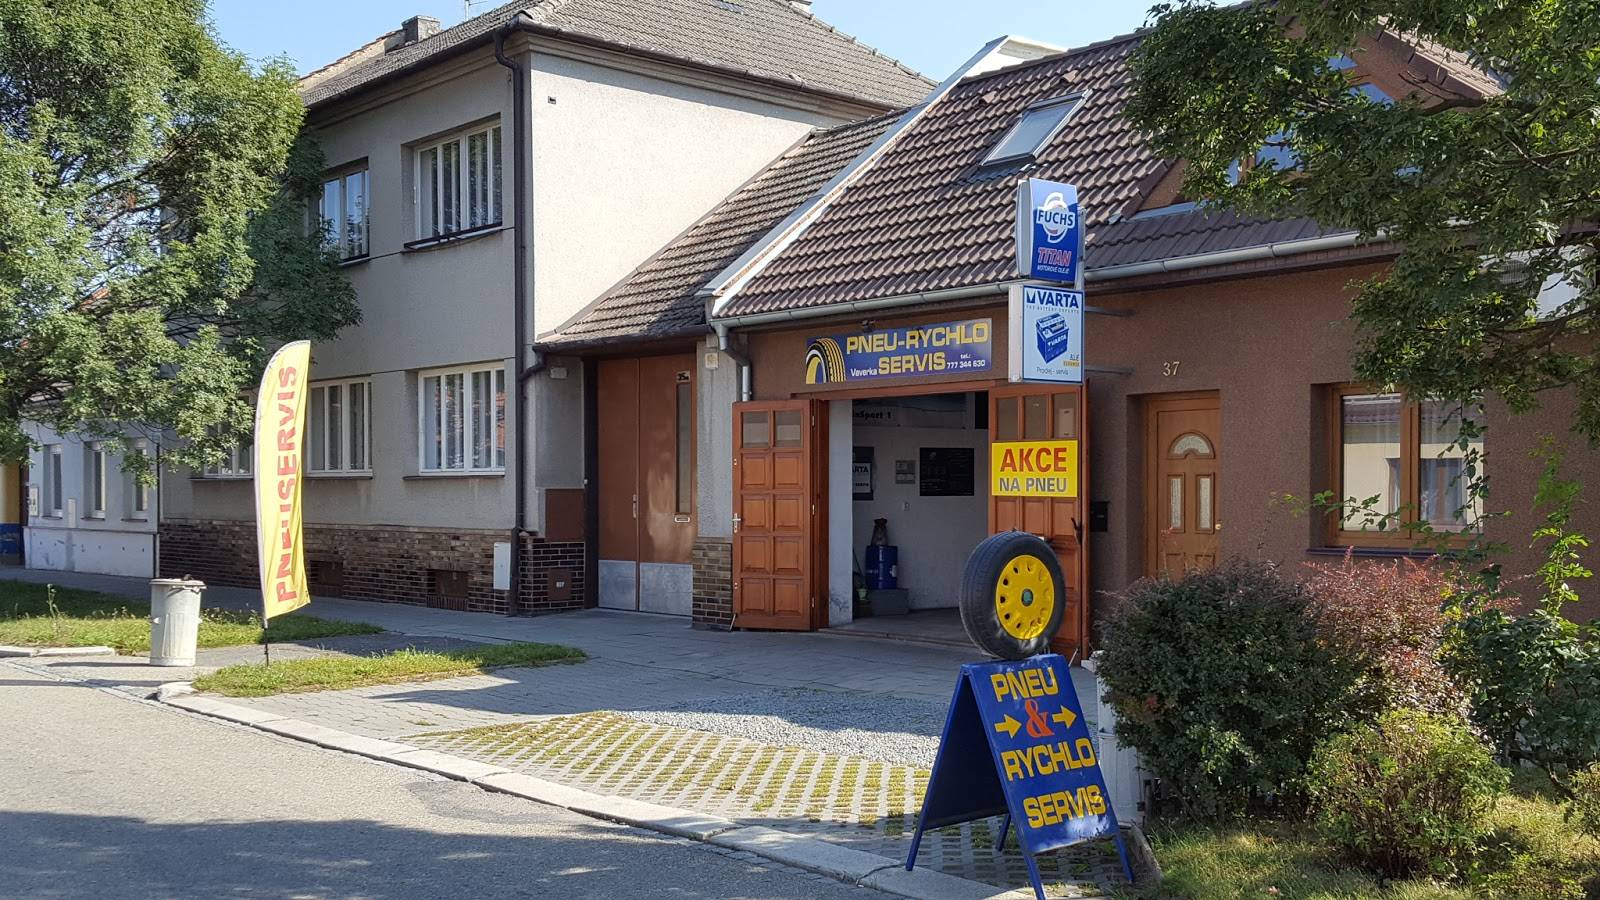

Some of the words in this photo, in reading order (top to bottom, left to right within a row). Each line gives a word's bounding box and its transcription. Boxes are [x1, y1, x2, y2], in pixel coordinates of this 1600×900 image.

[1038, 211, 1074, 226] FUCHS
[1038, 247, 1072, 266] TITAN
[1037, 290, 1079, 308] VARTA
[846, 322, 989, 354] PNEU-RYCHLO
[878, 352, 946, 375] SERVIS
[947, 361, 958, 369] 777
[1162, 361, 1180, 376] 37
[1000, 447, 1067, 472] AKCE
[999, 477, 1020, 492] NA
[1026, 477, 1067, 493] PNEU
[990, 666, 1059, 702] PNEU
[1025, 699, 1055, 738] &
[1001, 737, 1096, 782] RYCHLO
[1023, 784, 1107, 829] SERVIS
